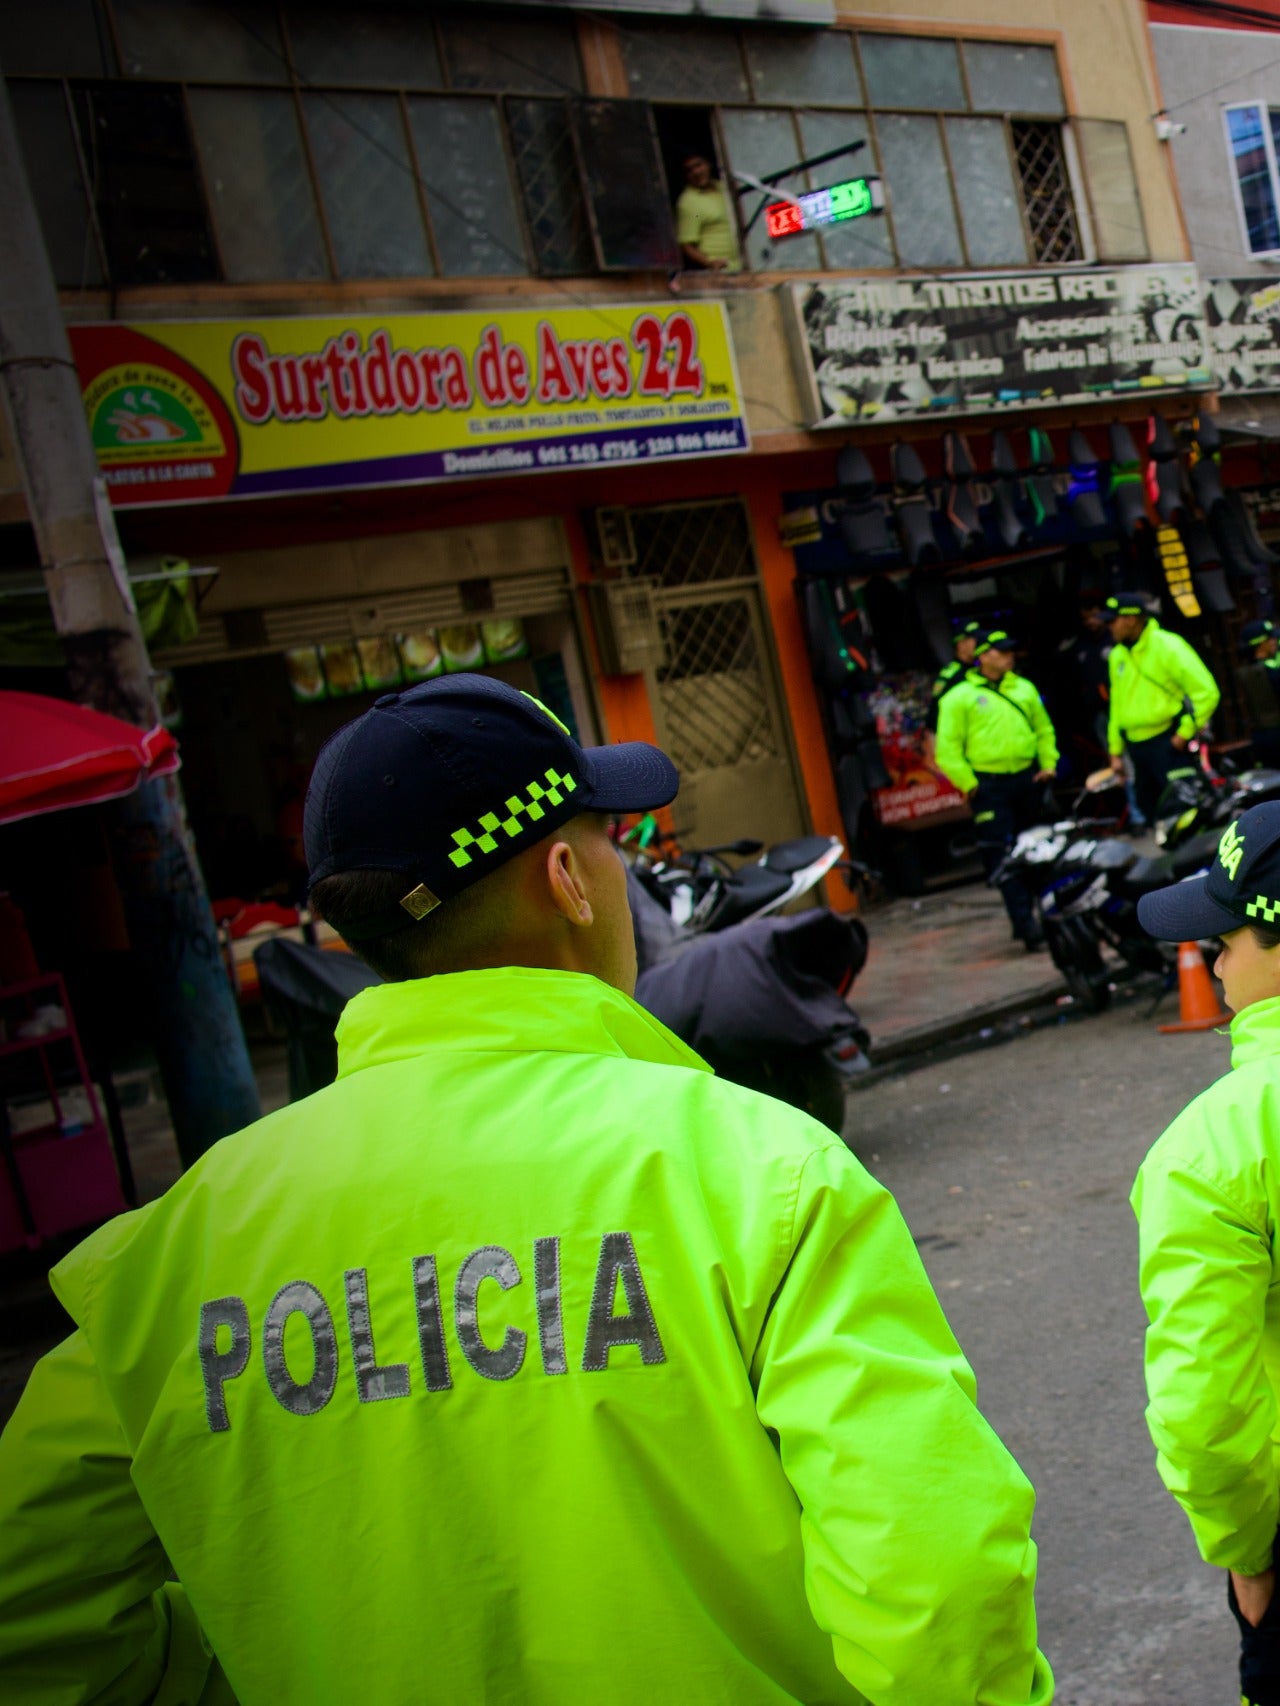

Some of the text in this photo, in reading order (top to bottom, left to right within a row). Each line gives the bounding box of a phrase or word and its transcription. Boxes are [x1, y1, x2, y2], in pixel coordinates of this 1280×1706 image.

[232, 311, 703, 422] Surtidora de Aves 22
[198, 1231, 667, 1433] POLICIA
